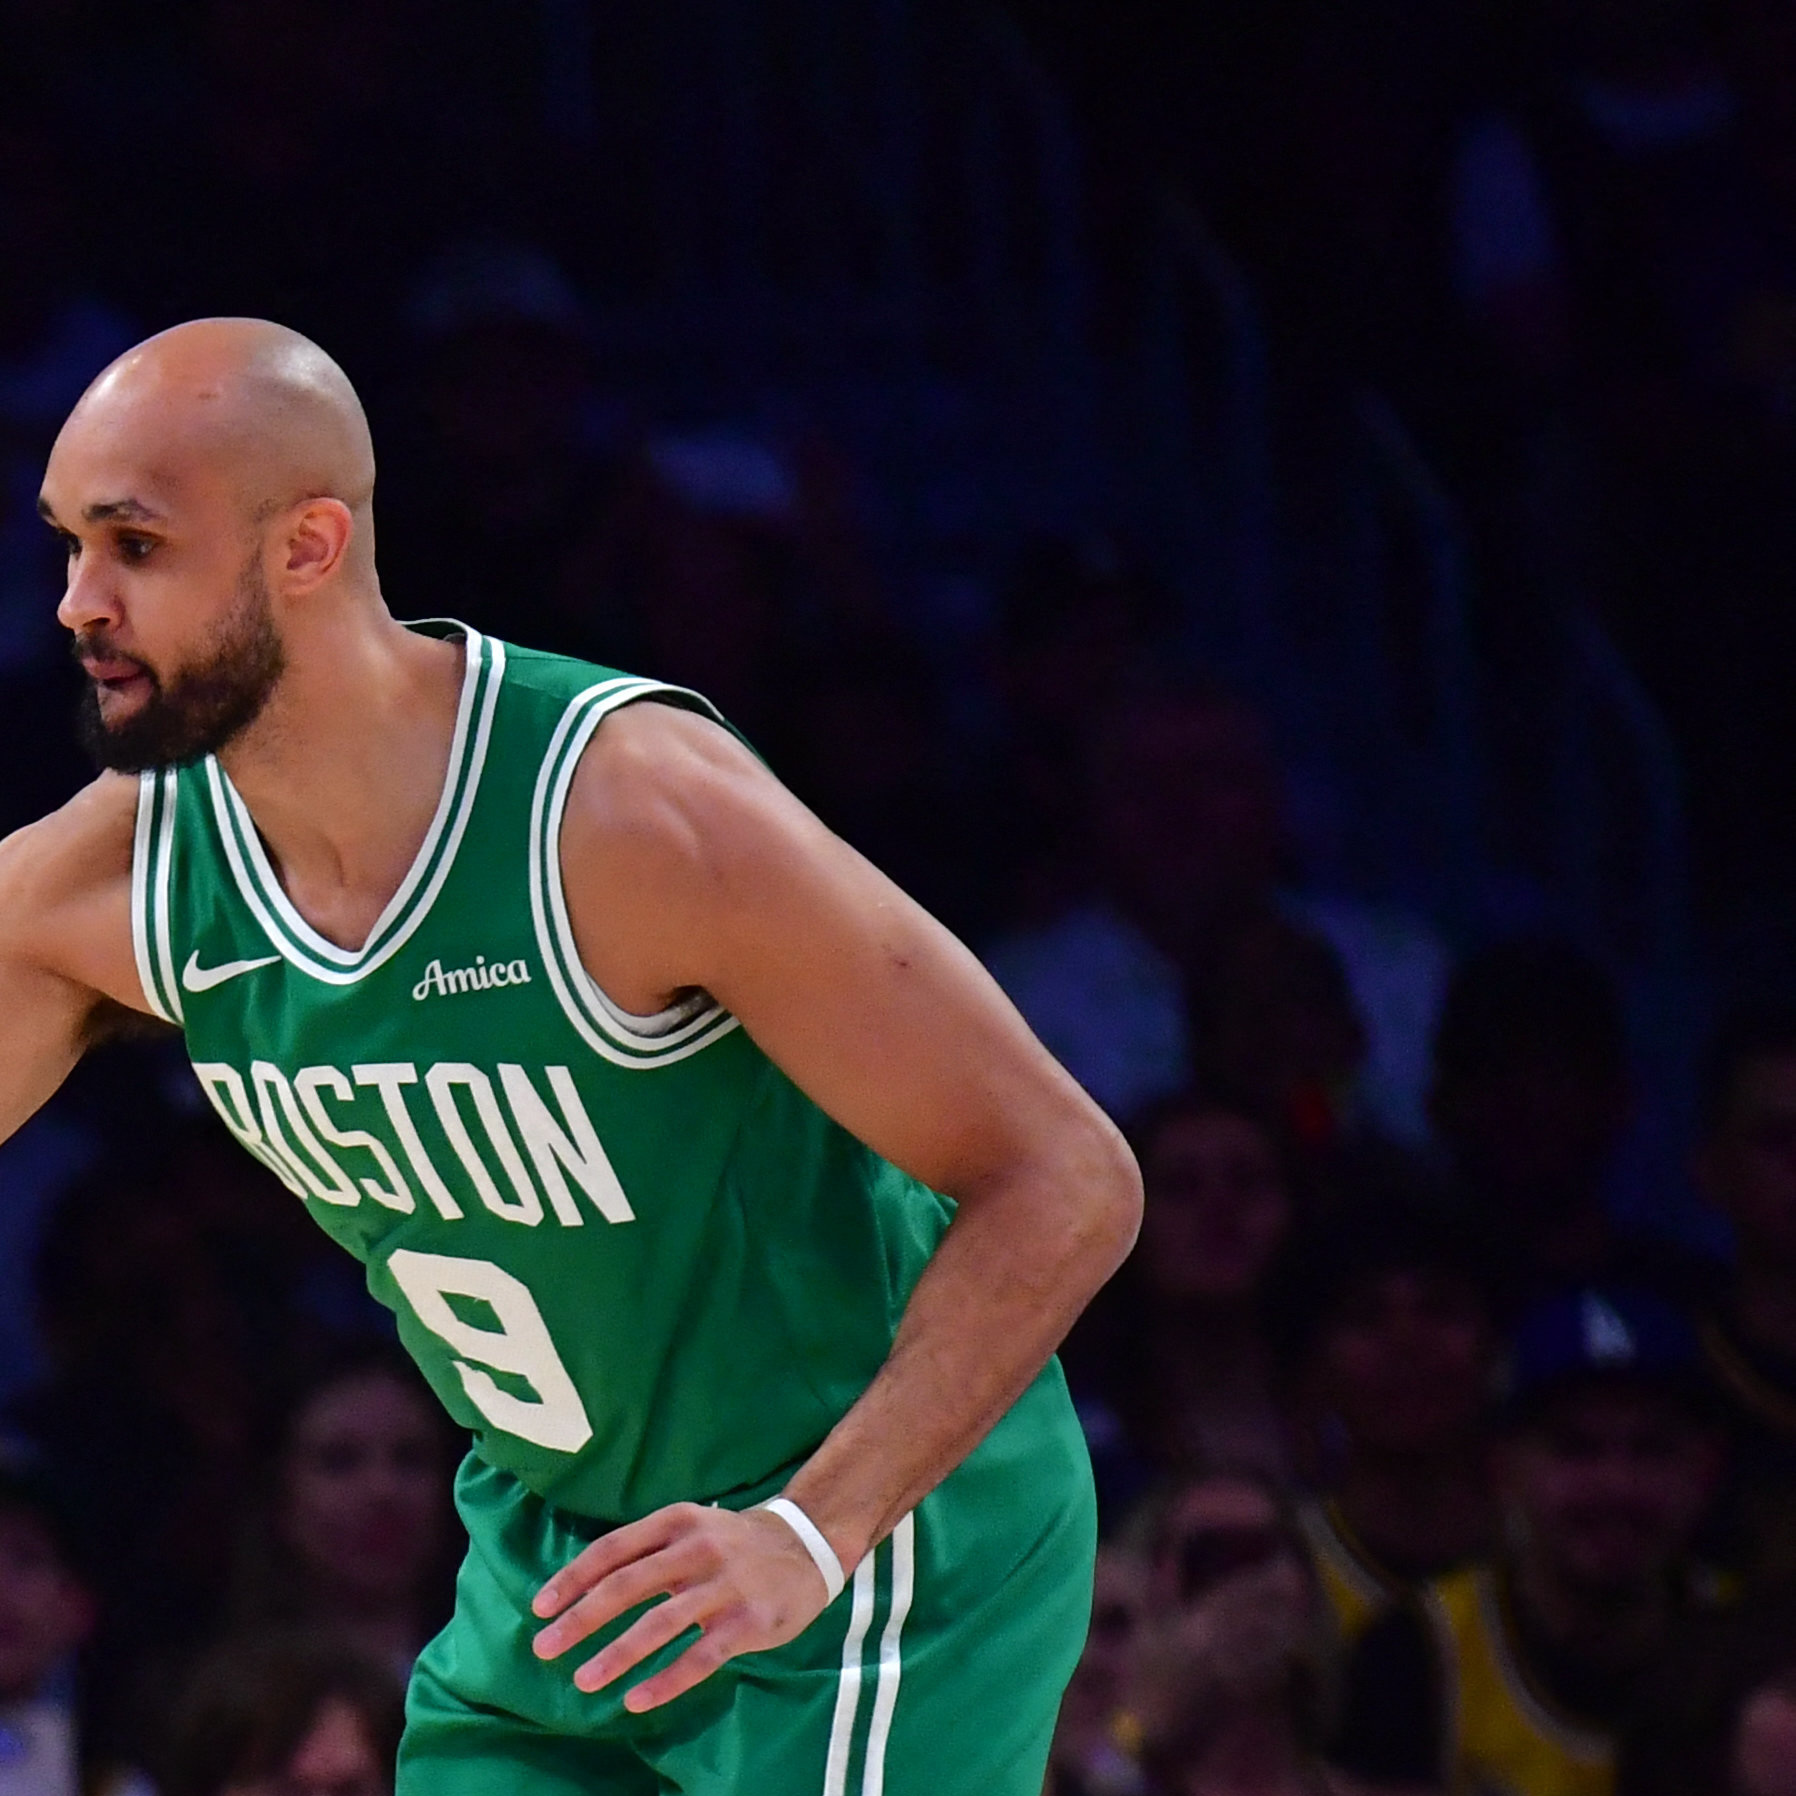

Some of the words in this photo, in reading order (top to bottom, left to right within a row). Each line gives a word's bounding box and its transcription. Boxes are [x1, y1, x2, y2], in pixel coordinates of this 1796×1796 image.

[412, 956, 532, 1001] Amica
[192, 1060, 636, 1227] BOSTON
[388, 1248, 593, 1453] 9
